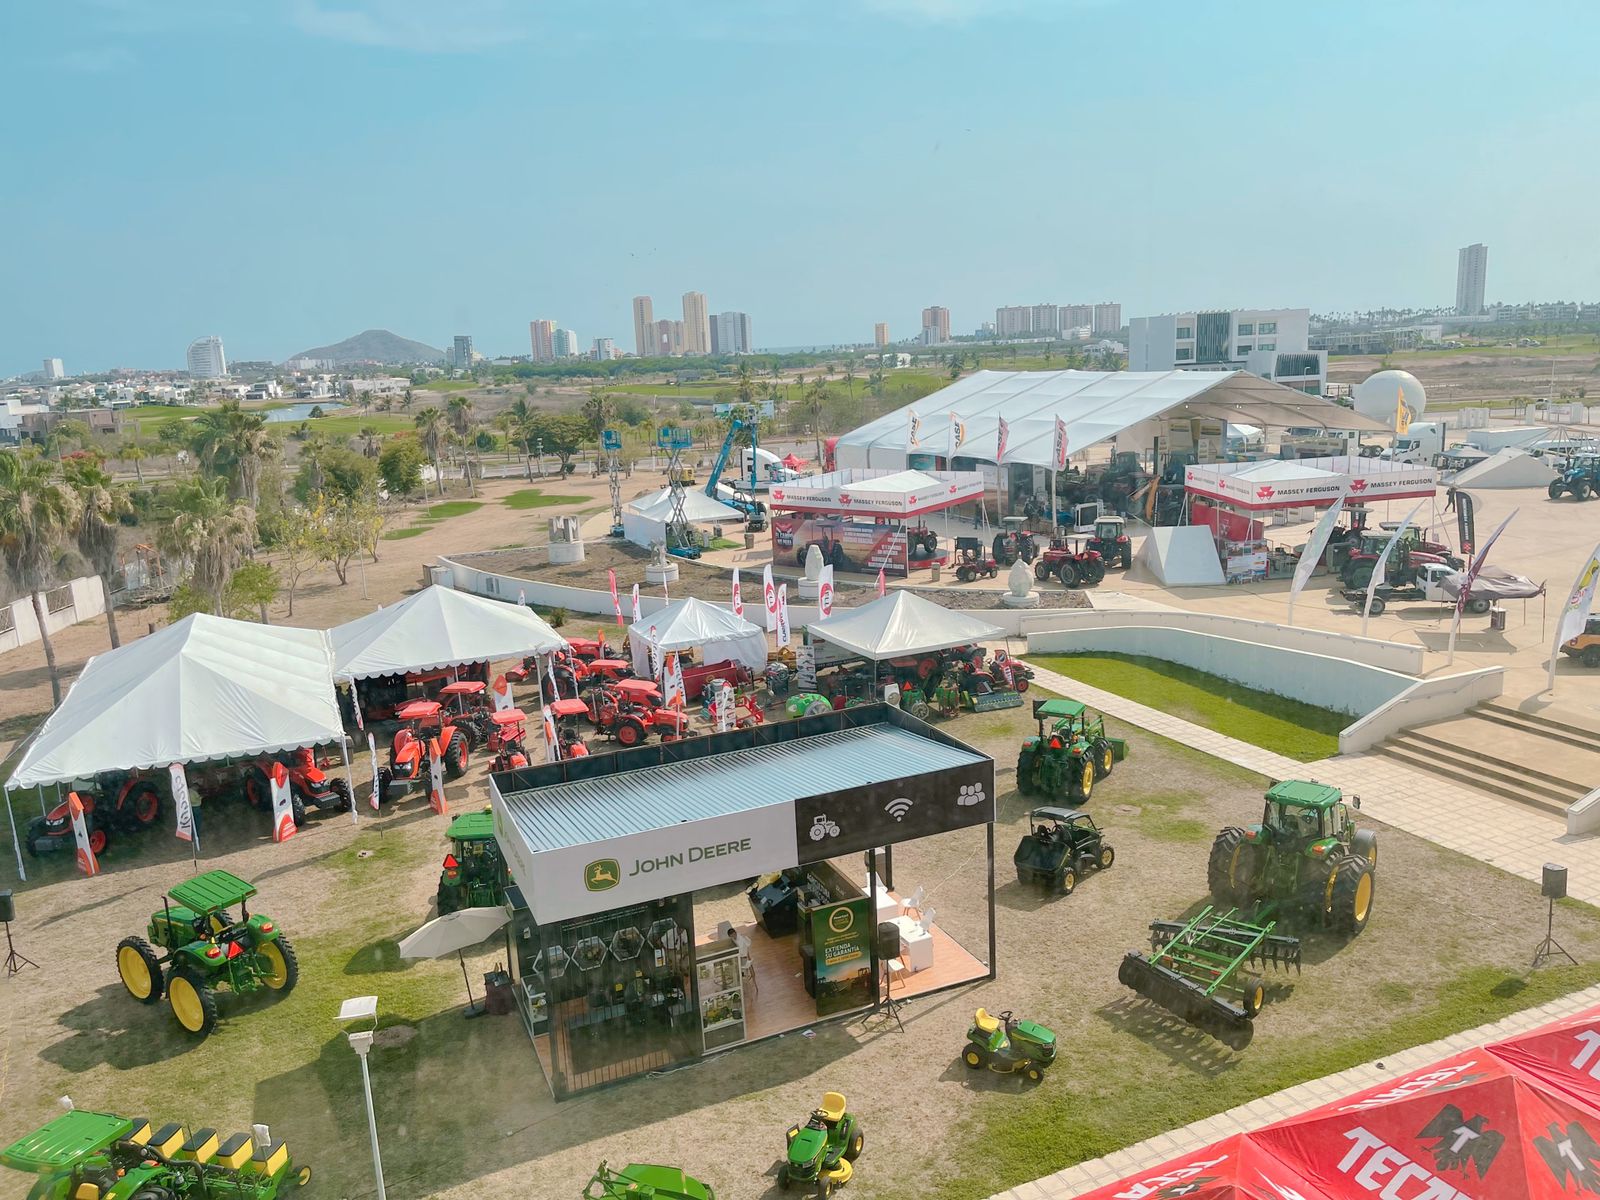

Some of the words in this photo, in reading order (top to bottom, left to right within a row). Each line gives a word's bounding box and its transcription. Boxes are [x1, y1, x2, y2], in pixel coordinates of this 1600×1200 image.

[1277, 488, 1304, 496] MASSEY
[1306, 486, 1340, 494] FERGUSON
[1371, 480, 1397, 488] MASSEY
[1399, 478, 1432, 486] FERGUSON
[629, 853, 683, 877] JOHN
[688, 838, 752, 863] DEERE
[825, 942, 851, 954] EXTIENDA
[1570, 1029, 1600, 1081] T
[1336, 1126, 1474, 1200] TEC
